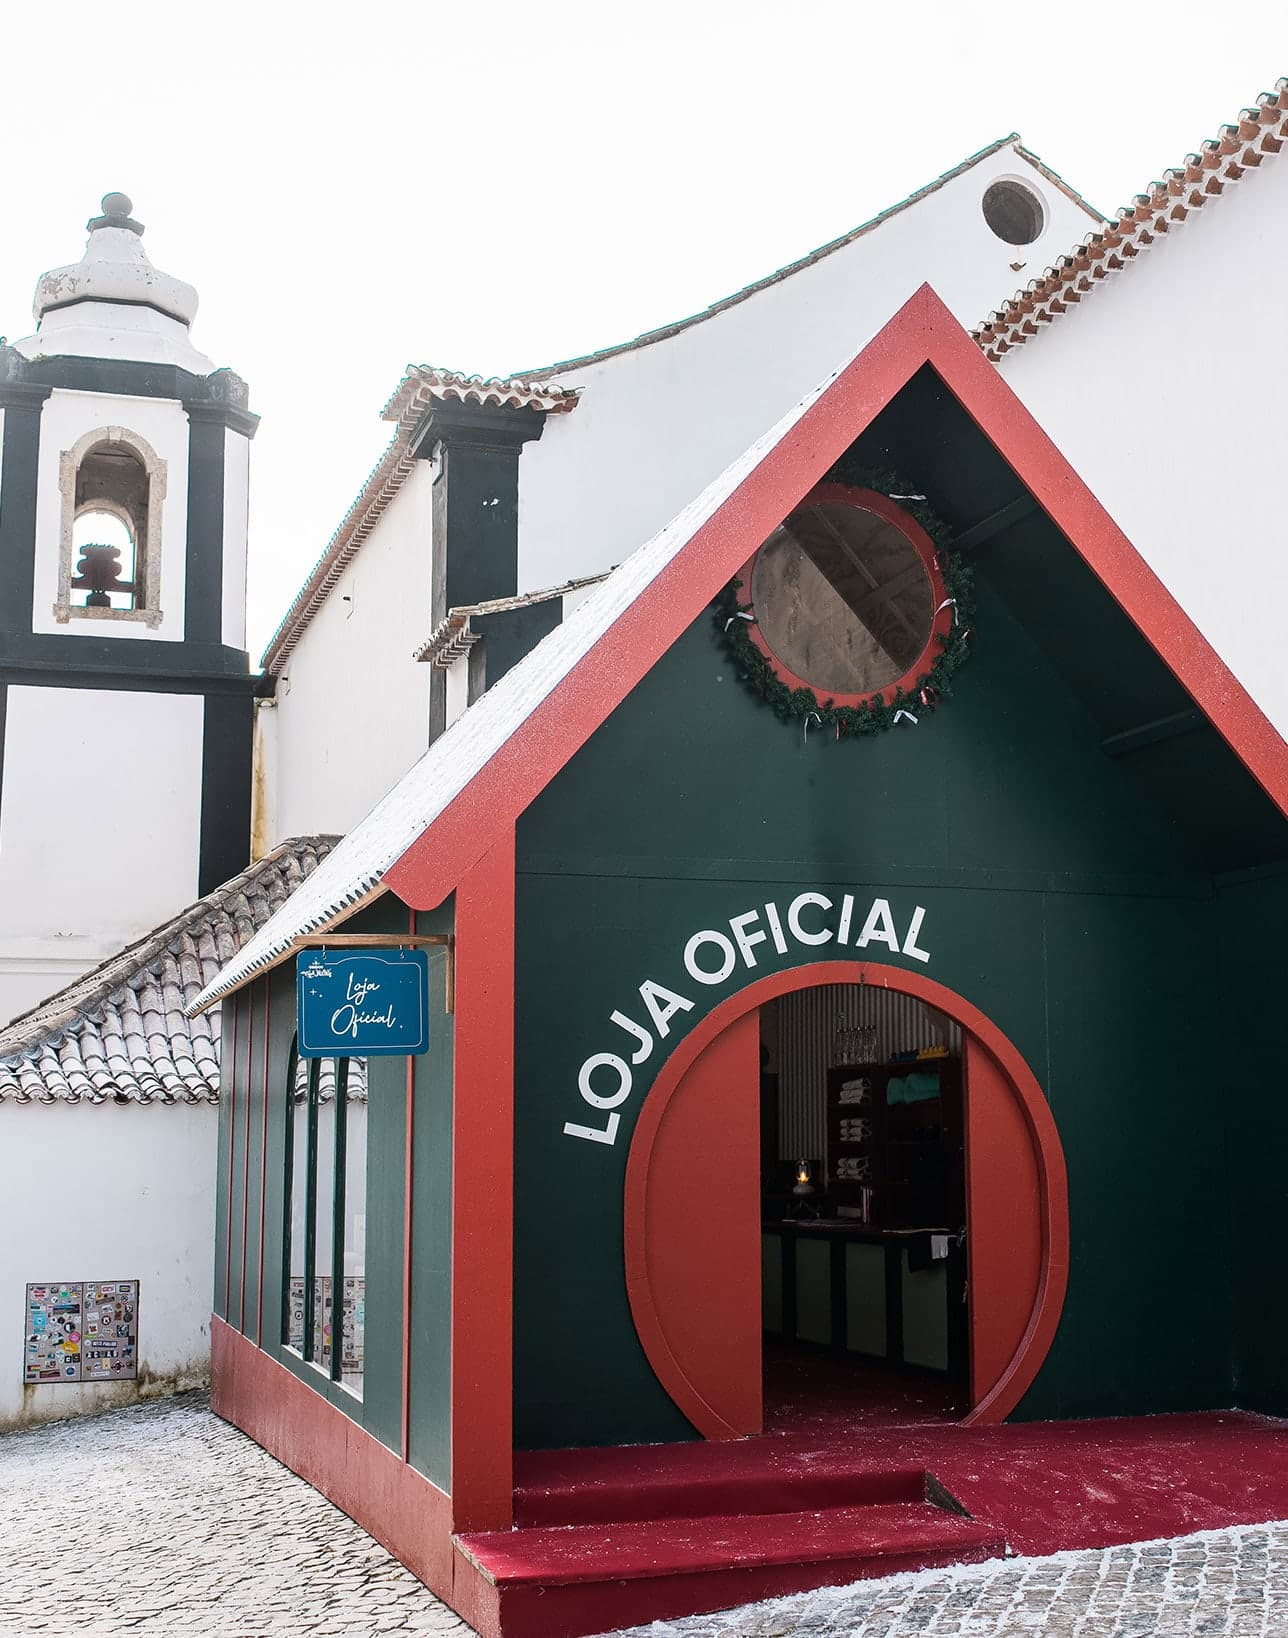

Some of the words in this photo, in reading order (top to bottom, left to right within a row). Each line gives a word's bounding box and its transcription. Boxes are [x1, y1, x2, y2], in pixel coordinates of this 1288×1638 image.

[346, 972, 381, 1006] Loja
[330, 1004, 396, 1038] Oficial
[563, 979, 696, 1146] LOJA
[683, 892, 931, 985] OFICIAL
